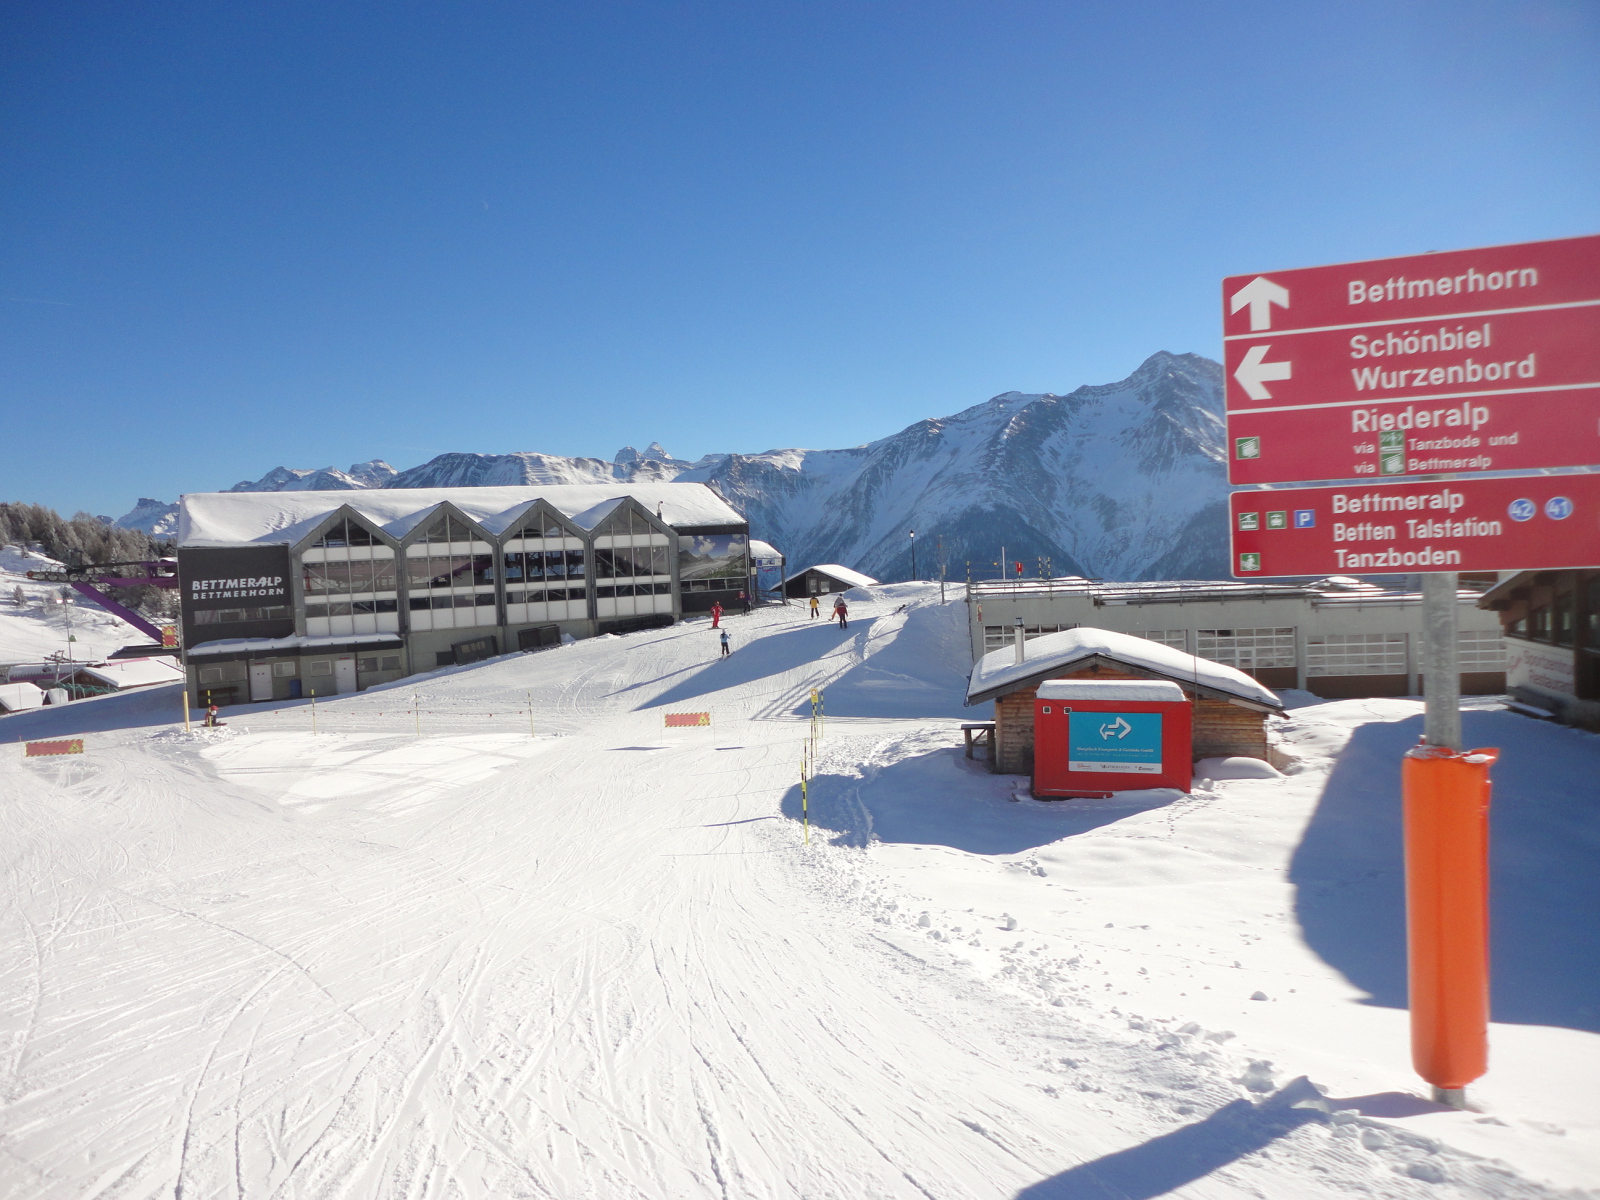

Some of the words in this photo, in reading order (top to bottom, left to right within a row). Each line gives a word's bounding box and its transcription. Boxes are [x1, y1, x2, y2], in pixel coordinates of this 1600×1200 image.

[1348, 266, 1538, 306] Bettmerhorn
[1349, 323, 1491, 360] Schönbiel
[1350, 353, 1537, 392] Wurzenbord
[1351, 402, 1490, 433] Riederalp
[1353, 441, 1375, 455] via
[1408, 435, 1481, 451] Tanzbode
[1489, 433, 1518, 446] und
[1353, 461, 1376, 474] via
[1408, 455, 1492, 472] Bettmeralp
[1332, 488, 1464, 514] Bettmeralp
[1510, 501, 1533, 518] 42
[1548, 500, 1570, 516] 41
[1298, 512, 1311, 526] P
[1333, 522, 1396, 542] Betten
[1406, 516, 1502, 540] Talstation
[1334, 546, 1461, 569] Tanzboden
[192, 577, 282, 590] BETTMERALP
[193, 589, 283, 599] BETTMERHORN
